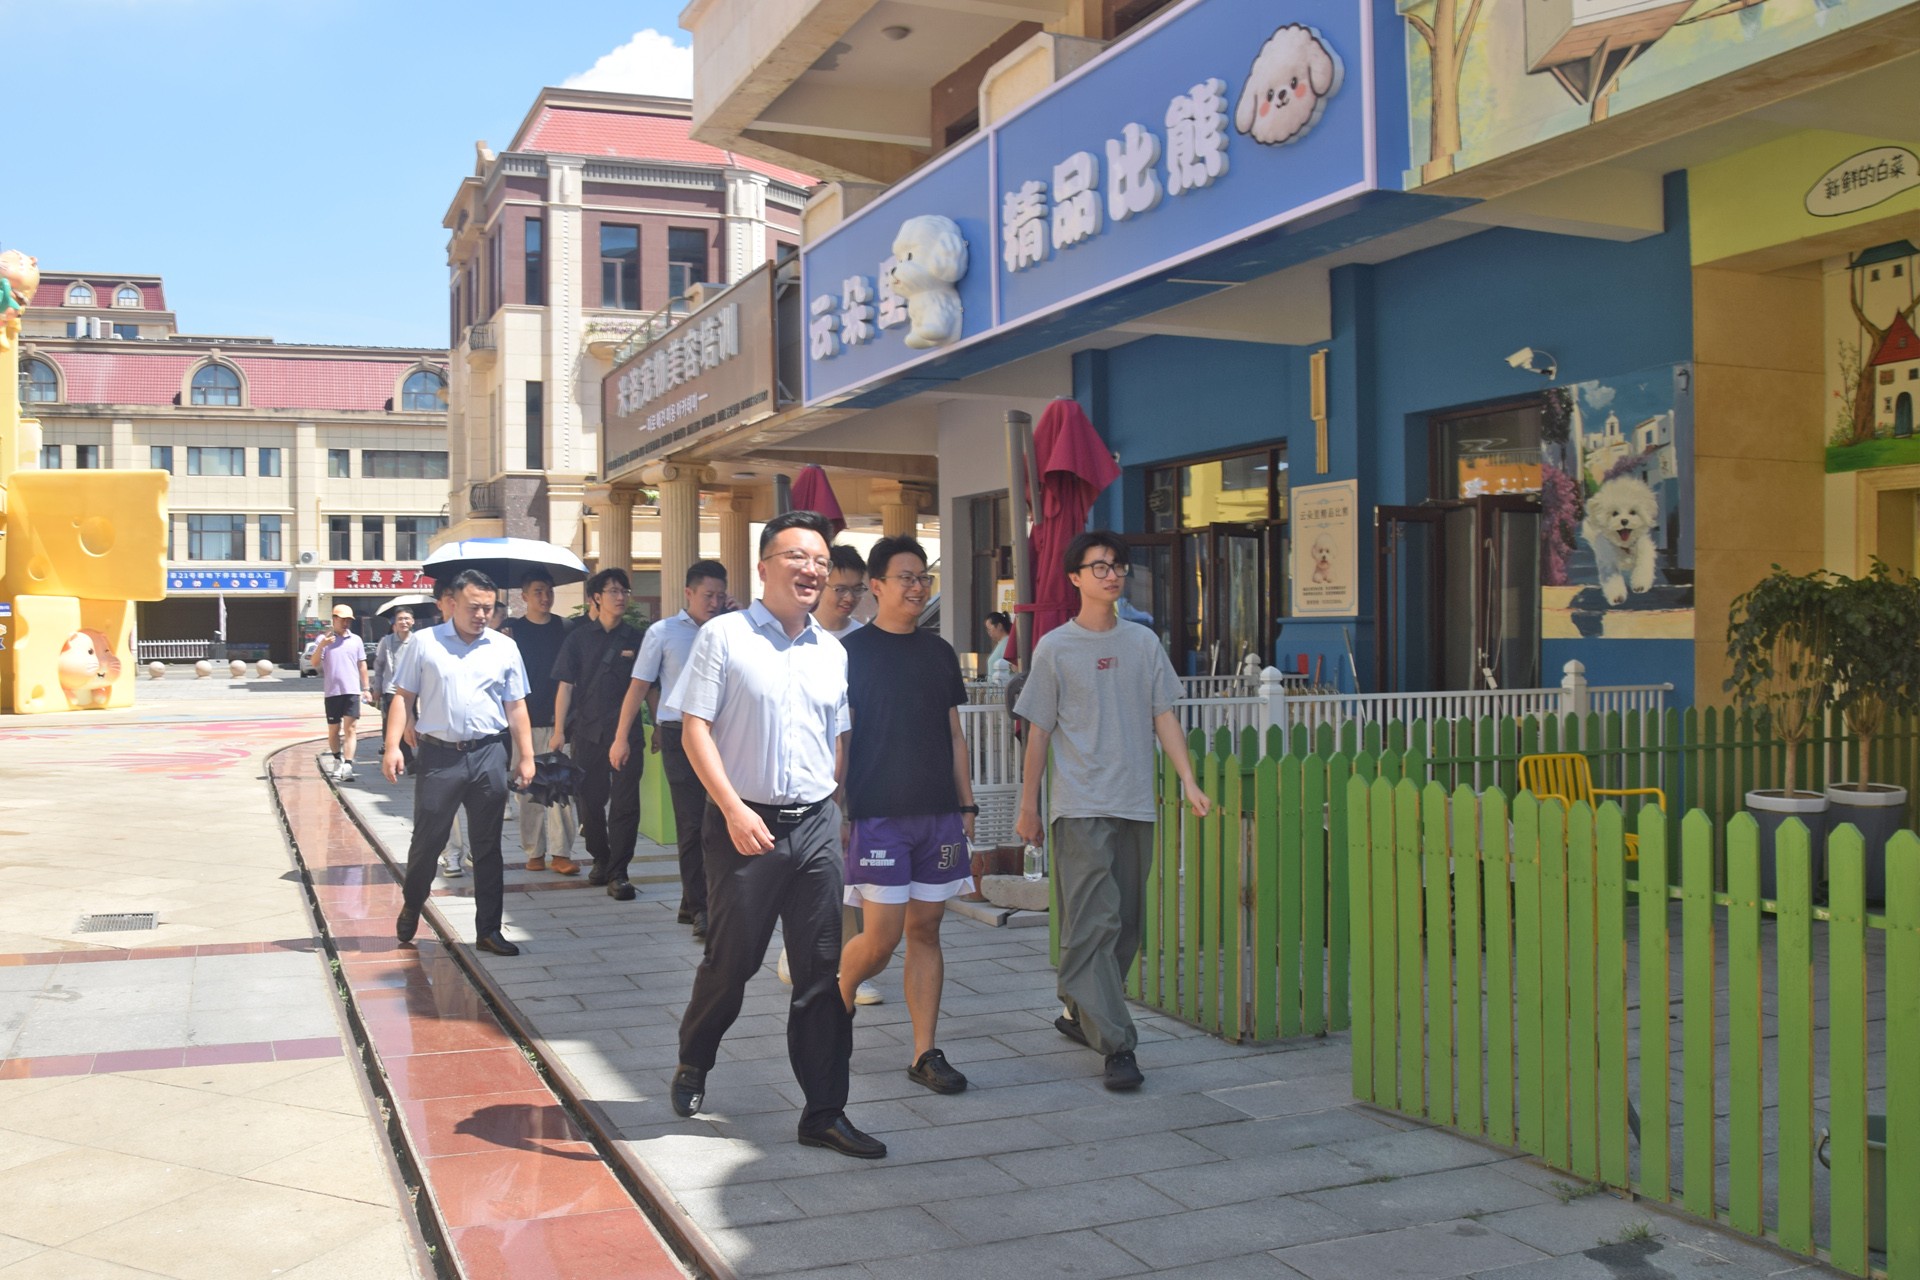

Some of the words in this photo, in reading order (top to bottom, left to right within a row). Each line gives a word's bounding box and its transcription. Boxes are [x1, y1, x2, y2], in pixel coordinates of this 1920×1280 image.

[1002, 77, 1229, 273] 精品比熊
[1825, 154, 1905, 199] 新鲜的白菜
[809, 256, 912, 361] 云朵里
